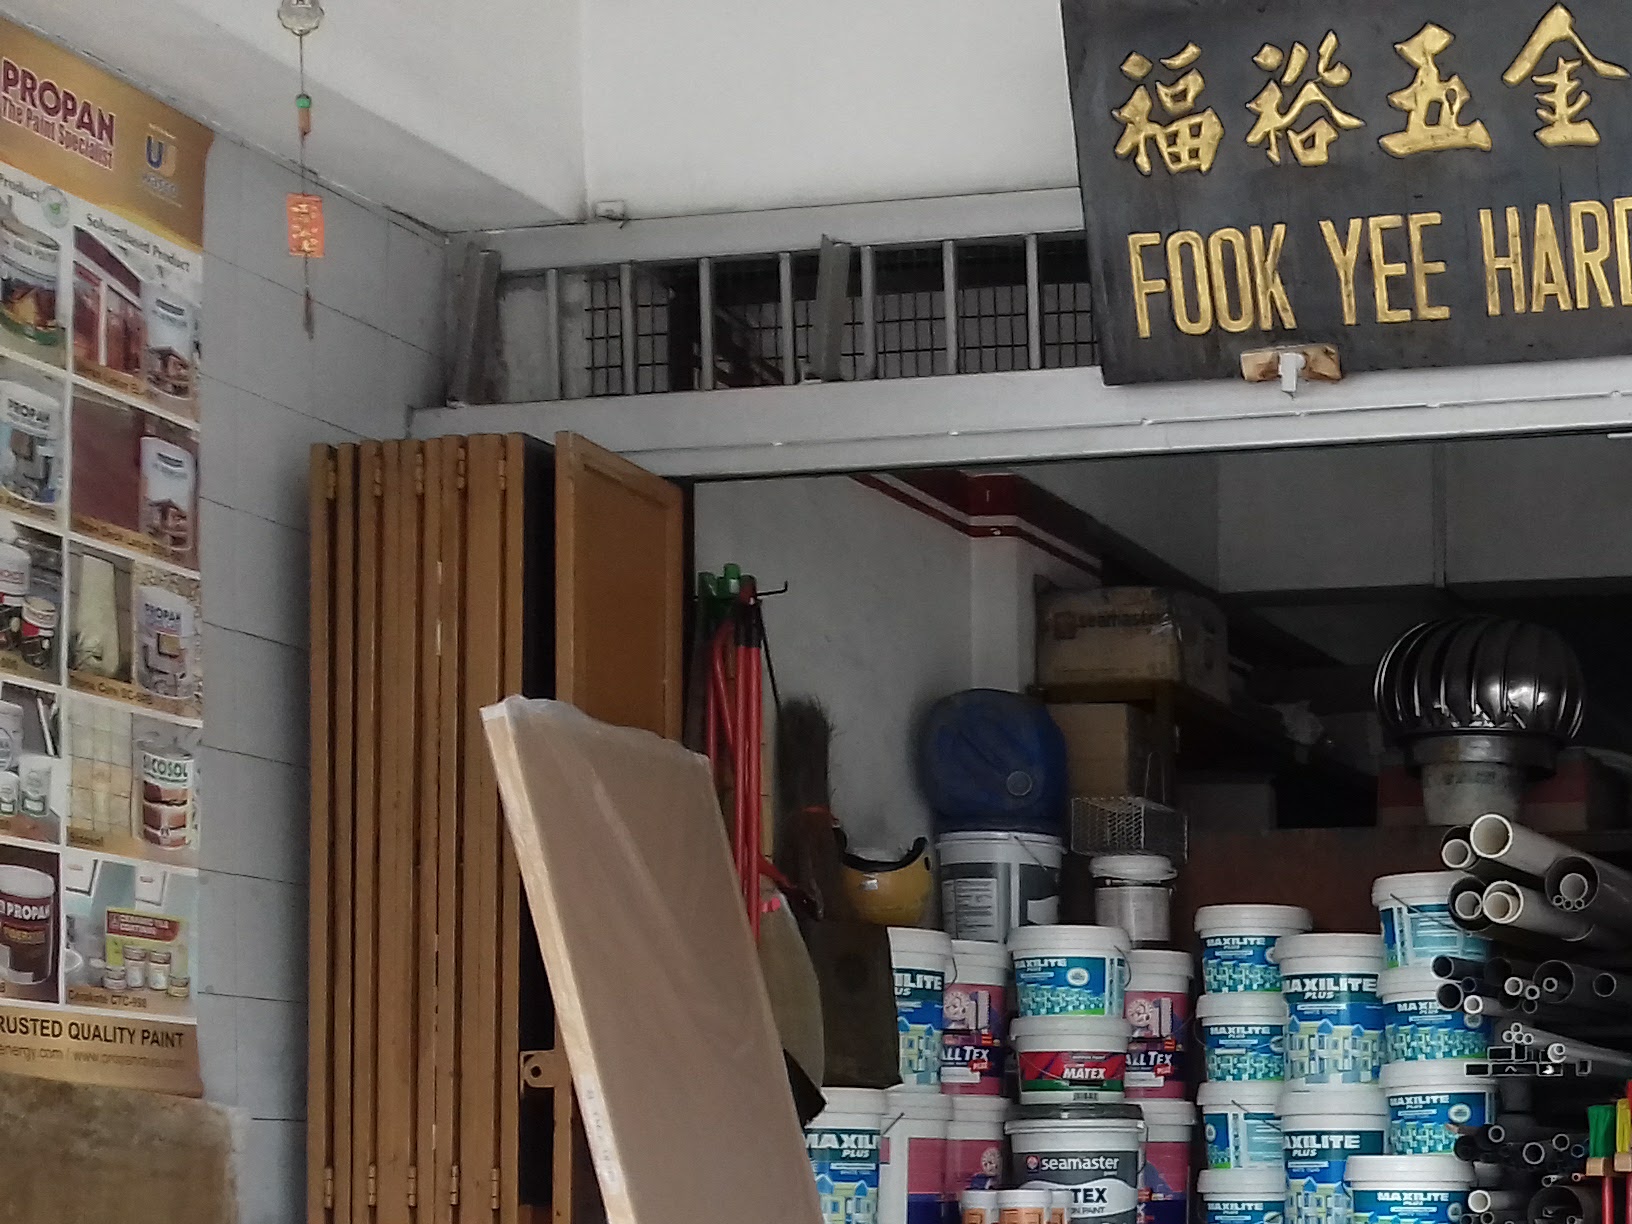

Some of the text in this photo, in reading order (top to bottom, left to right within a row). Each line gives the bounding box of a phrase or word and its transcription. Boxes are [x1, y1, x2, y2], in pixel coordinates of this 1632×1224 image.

[2, 56, 116, 146] PROPAN
[3, 95, 22, 124] The
[26, 106, 56, 141] Paint
[1131, 223, 1297, 339] FOOK
[1321, 212, 1451, 327] YEE
[6, 902, 51, 921] PROPAN
[895, 971, 943, 990] ILITE
[1303, 990, 1335, 1000] PLUS
[68, 1021, 136, 1045] QUALITY
[141, 1028, 184, 1048] PAINT
[1062, 1067, 1106, 1080] MATEX
[805, 1133, 881, 1150] MAXIL
[1281, 1134, 1361, 1150] AXILITE
[840, 1149, 870, 1158] PLUS
[1292, 1148, 1318, 1157] PLUS
[1041, 1156, 1120, 1171] seamaster
[1377, 1192, 1450, 1202] MAXILITE
